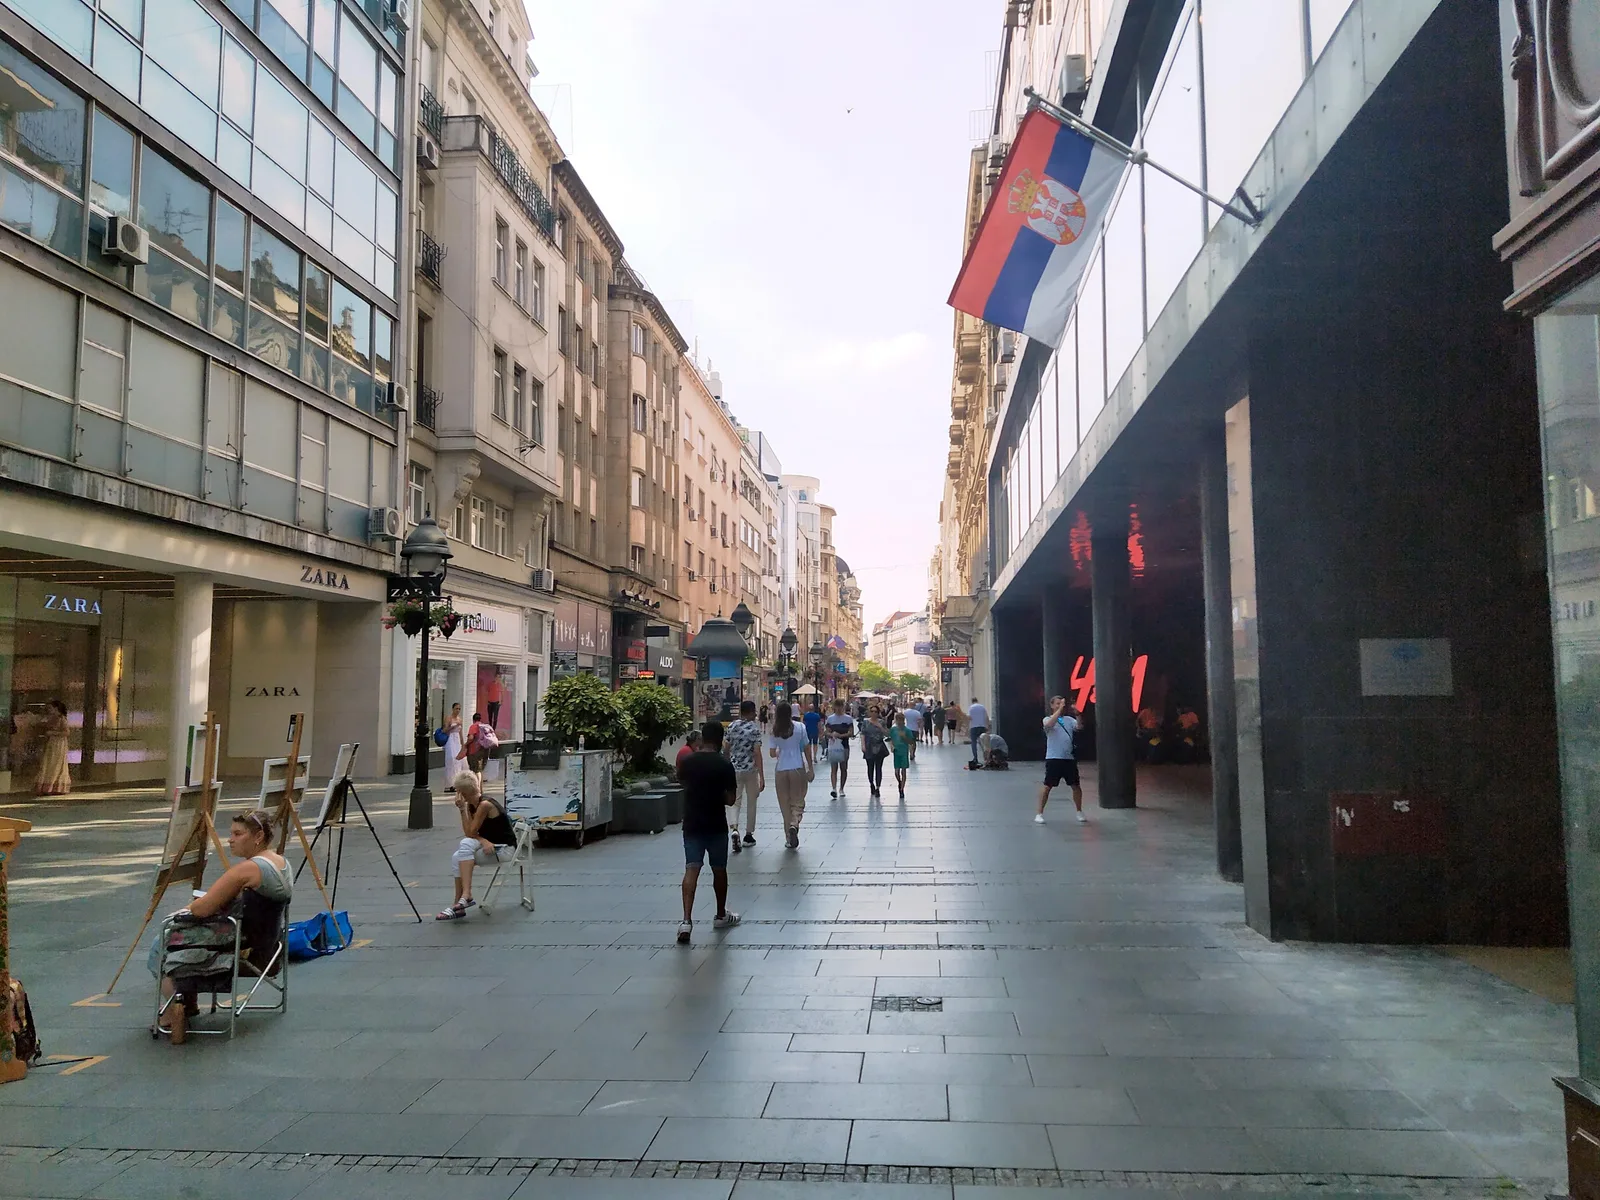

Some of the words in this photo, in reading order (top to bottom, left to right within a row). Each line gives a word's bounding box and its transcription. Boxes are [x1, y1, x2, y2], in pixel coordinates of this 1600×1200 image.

[300, 565, 350, 590] ZARA
[44, 594, 102, 615] ZARA
[659, 655, 674, 668] ALDO
[245, 686, 301, 697] ZARA
